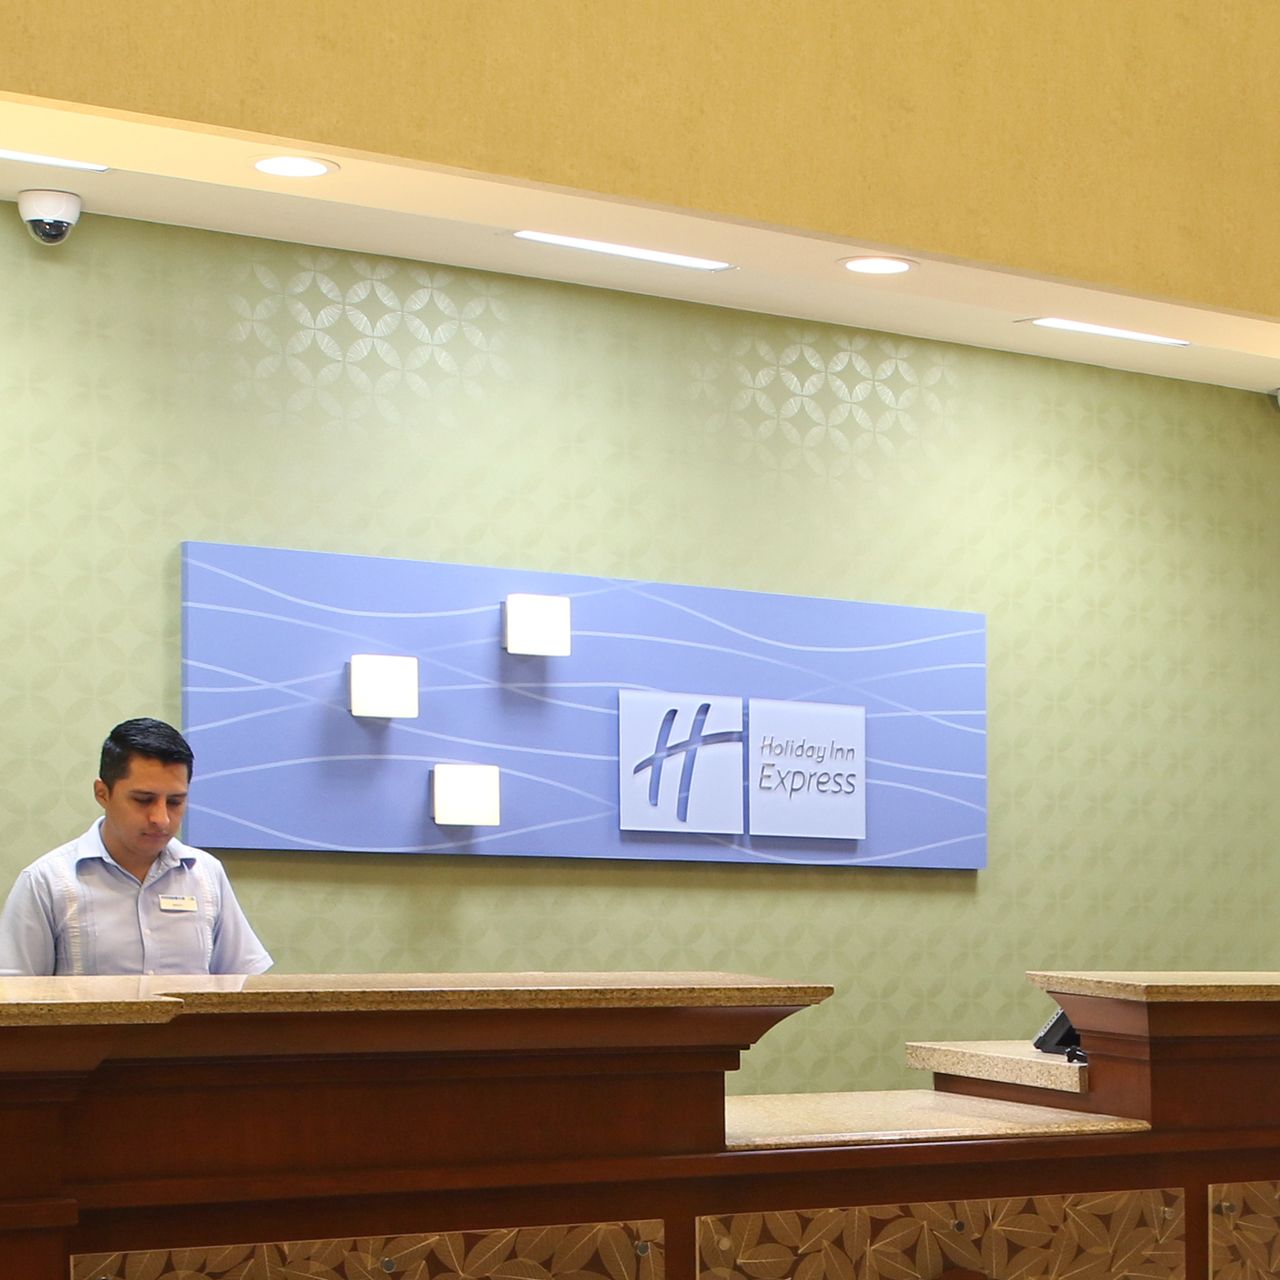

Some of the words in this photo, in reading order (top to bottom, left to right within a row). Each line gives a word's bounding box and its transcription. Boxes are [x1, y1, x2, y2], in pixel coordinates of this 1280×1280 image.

[760, 736, 827, 763] Holiday
[830, 740, 855, 760] Inn
[759, 763, 856, 799] Express
